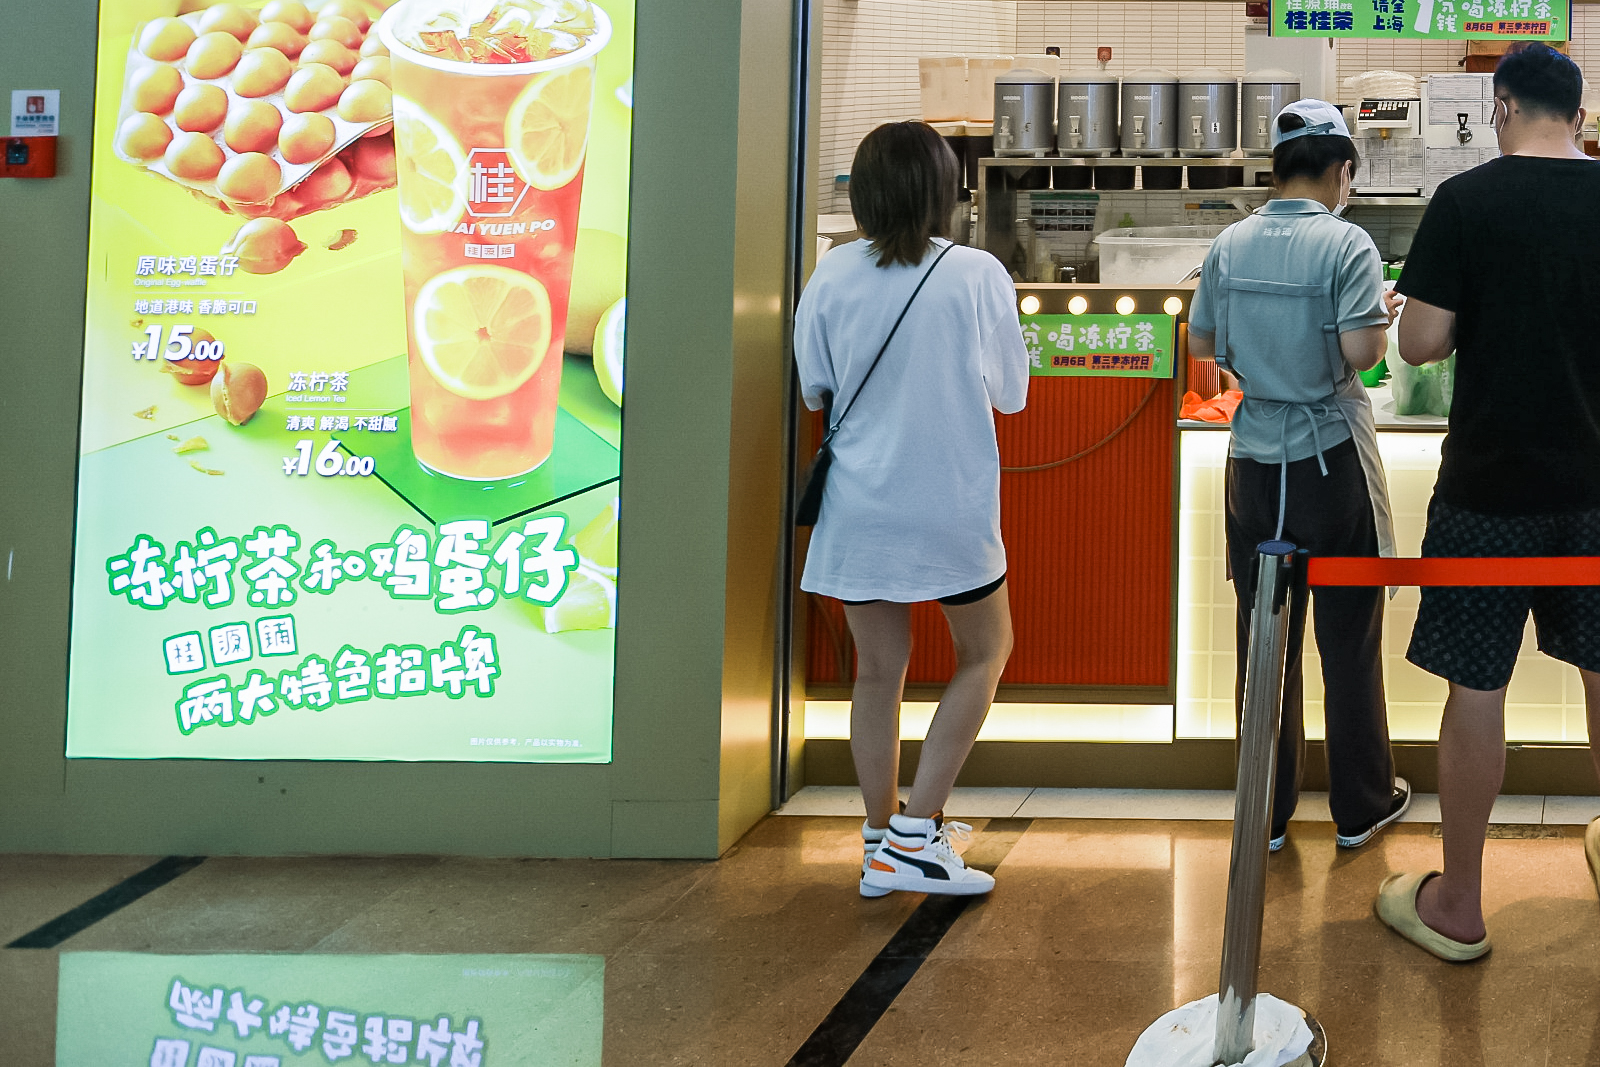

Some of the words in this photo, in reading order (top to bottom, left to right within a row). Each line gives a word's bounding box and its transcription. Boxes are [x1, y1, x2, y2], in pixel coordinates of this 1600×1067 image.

[1372, 15, 1405, 33] 上海
[1465, 22, 1493, 32] 8月6日
[469, 162, 514, 203] 桂
[479, 222, 526, 236] YUEN
[529, 219, 556, 233] PO
[135, 255, 240, 276] 原味鸡蛋仔
[134, 278, 165, 288] Original
[134, 299, 193, 314] 地道港味
[198, 299, 257, 314] 香脆可口
[132, 324, 225, 362] ¥15.00
[1047, 321, 1155, 351] 喝冻柠茶
[1053, 356, 1086, 366] 8月6日
[1091, 355, 1150, 365] 第三季冻柠日
[287, 371, 350, 393] 冻柠茶
[285, 394, 303, 403] Iced
[304, 394, 332, 403] Lemon
[332, 394, 346, 403] Tea
[285, 416, 316, 432] 清爽
[319, 416, 350, 432] 解渴
[353, 416, 398, 432] 不甜腻
[281, 439, 376, 478] ¥16.00
[111, 516, 575, 609] 冻柠茶和鸡蛋仔
[179, 631, 496, 730] 两大特色招牌
